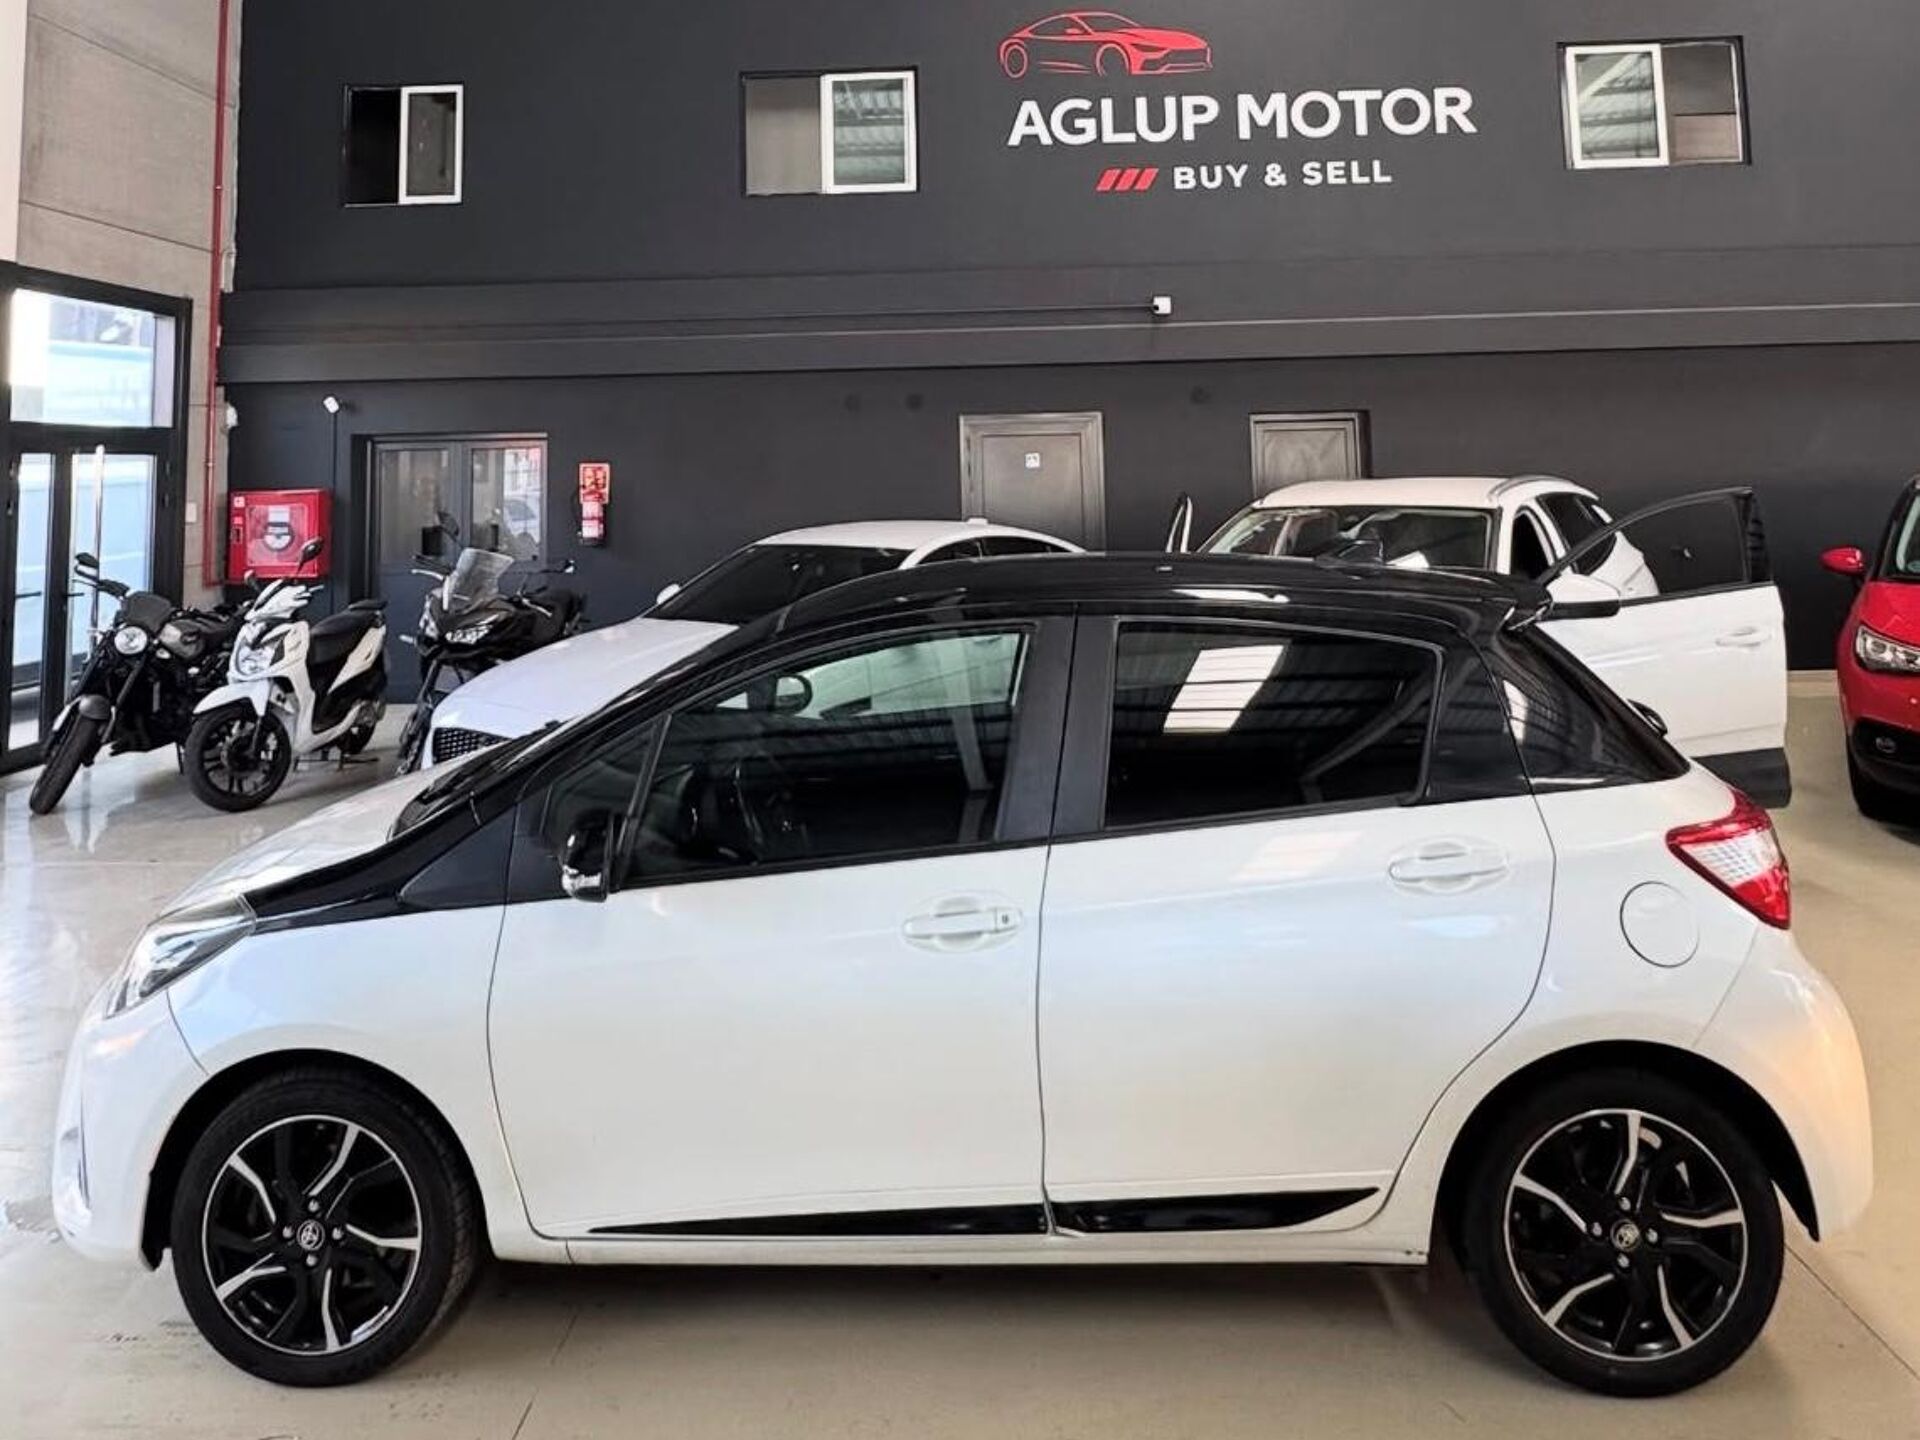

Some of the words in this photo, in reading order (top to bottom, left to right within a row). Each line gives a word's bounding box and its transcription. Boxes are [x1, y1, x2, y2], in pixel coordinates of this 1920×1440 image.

[1007, 95, 1220, 146] AGLUP
[1237, 86, 1478, 140] MOTOR
[1173, 164, 1249, 190] BUY
[1264, 162, 1287, 188] &
[1302, 159, 1393, 186] SELL
